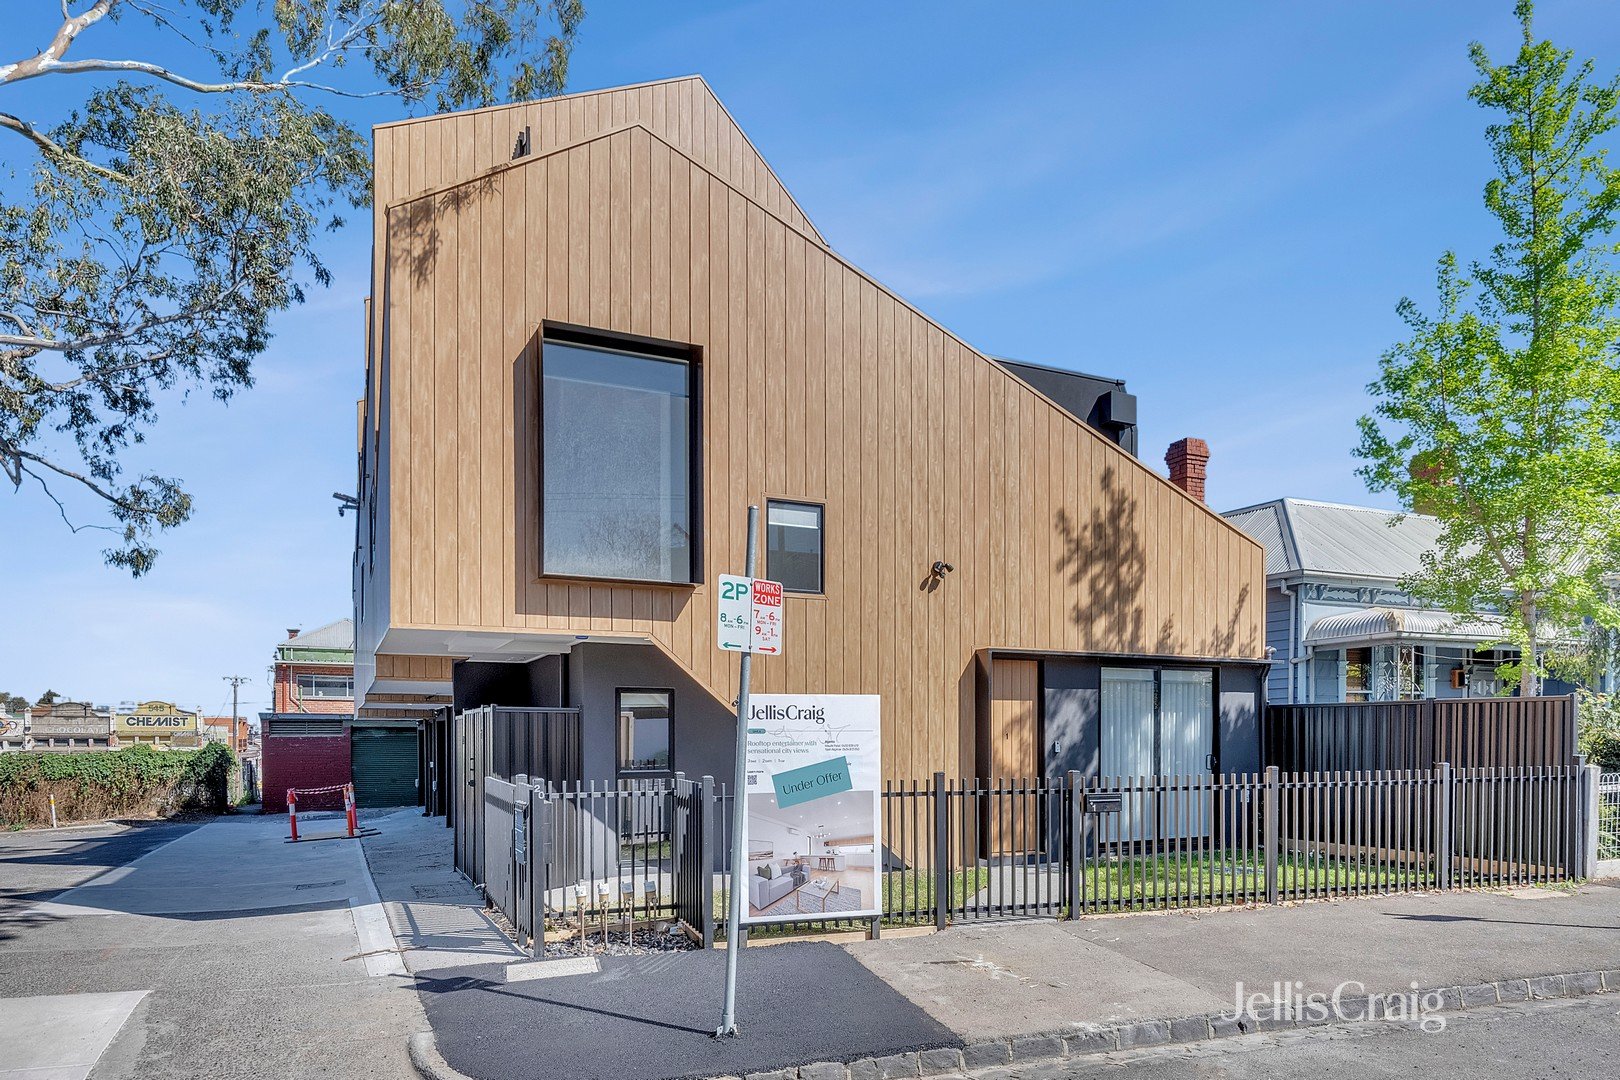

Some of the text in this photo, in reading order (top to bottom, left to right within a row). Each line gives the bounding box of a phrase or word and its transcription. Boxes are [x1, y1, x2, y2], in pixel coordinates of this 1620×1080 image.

[722, 582, 748, 600] 2P
[754, 582, 780, 595] WORKS
[754, 594, 781, 606] ZONE
[126, 717, 188, 726] CHEMIST
[748, 705, 825, 724] JellisCraig
[782, 772, 842, 795] Under Offer
[534, 784, 545, 799] 20
